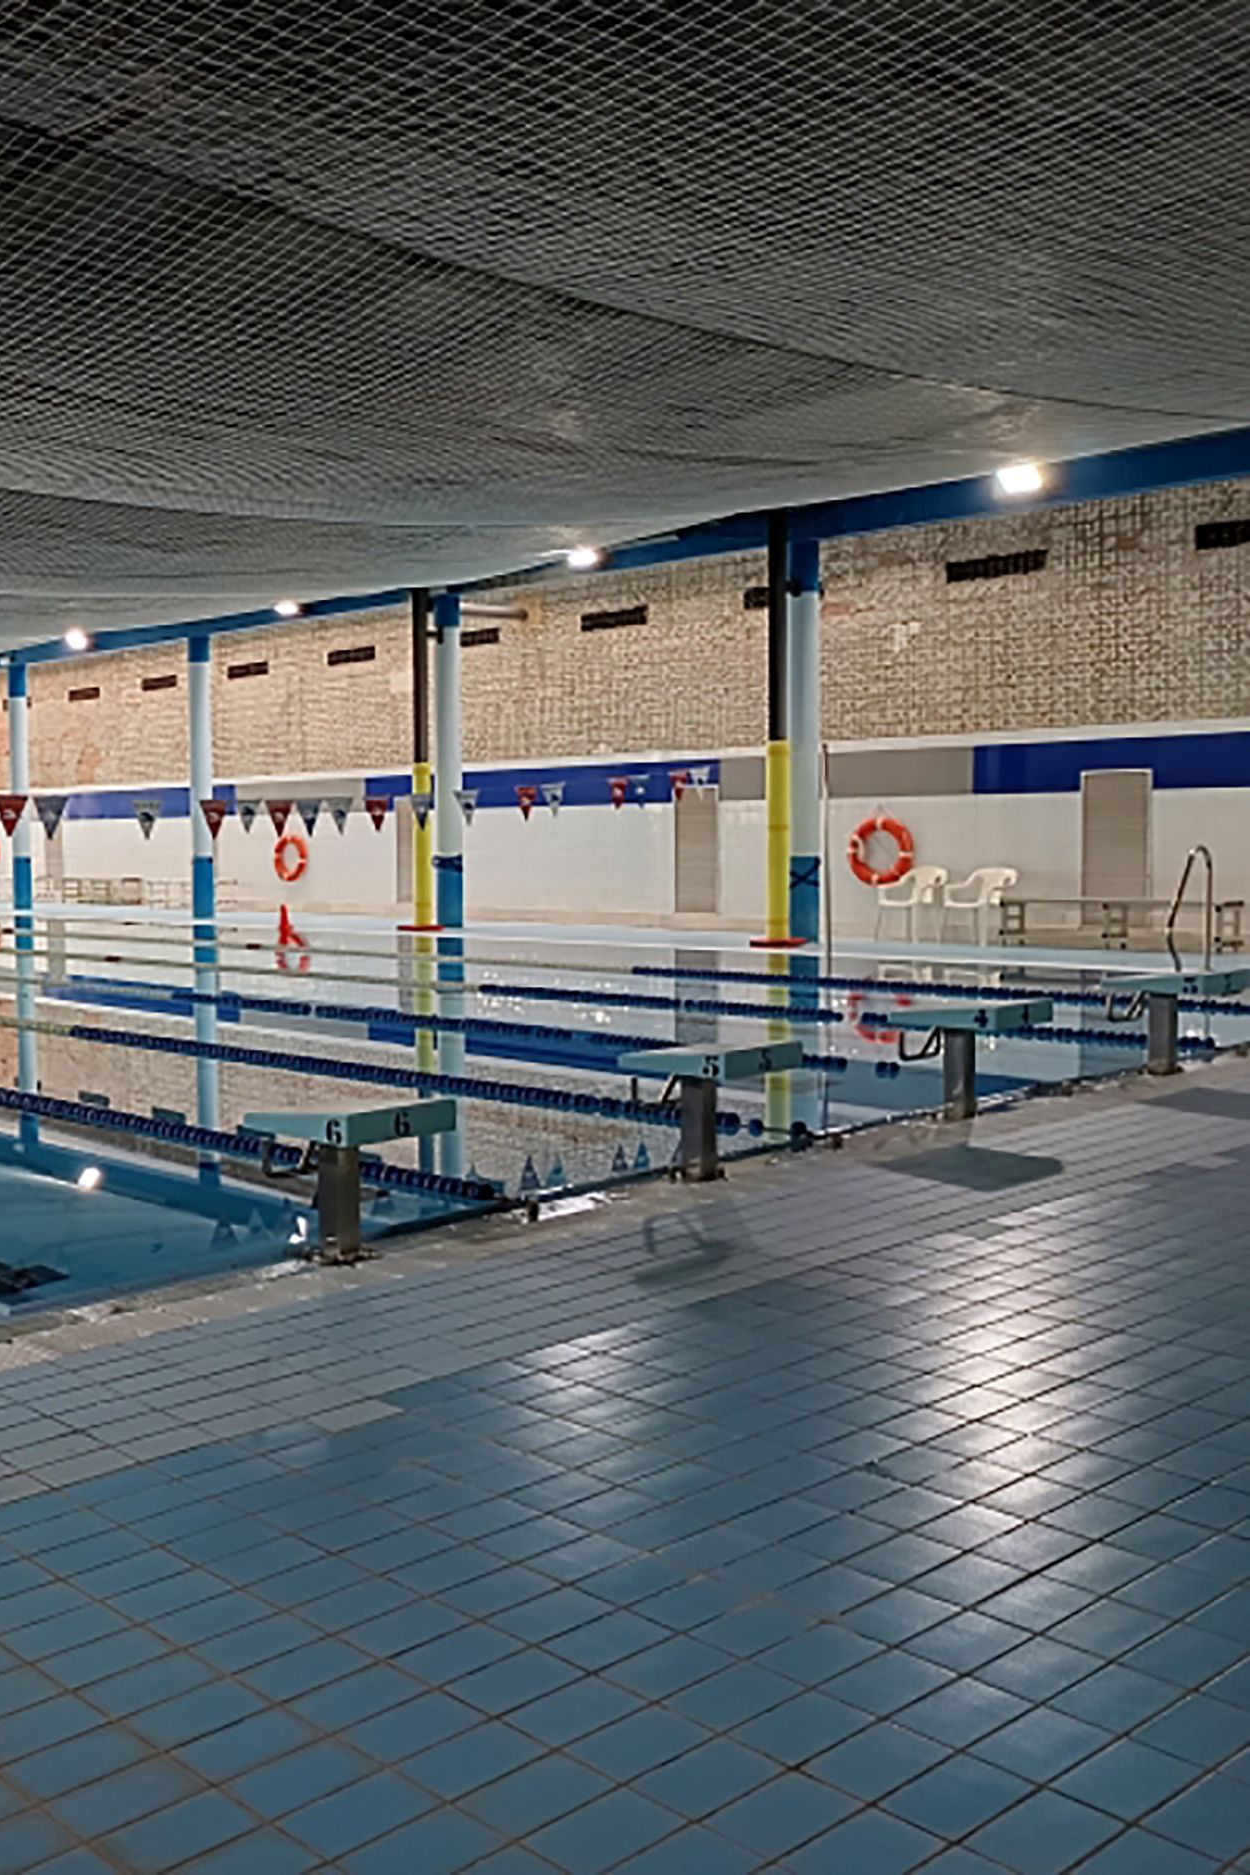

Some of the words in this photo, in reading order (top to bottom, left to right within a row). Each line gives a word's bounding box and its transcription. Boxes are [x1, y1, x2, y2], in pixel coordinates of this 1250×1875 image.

[702, 1055, 720, 1077] 5
[325, 1118, 342, 1145] 6
[394, 1110, 411, 1137] 6
